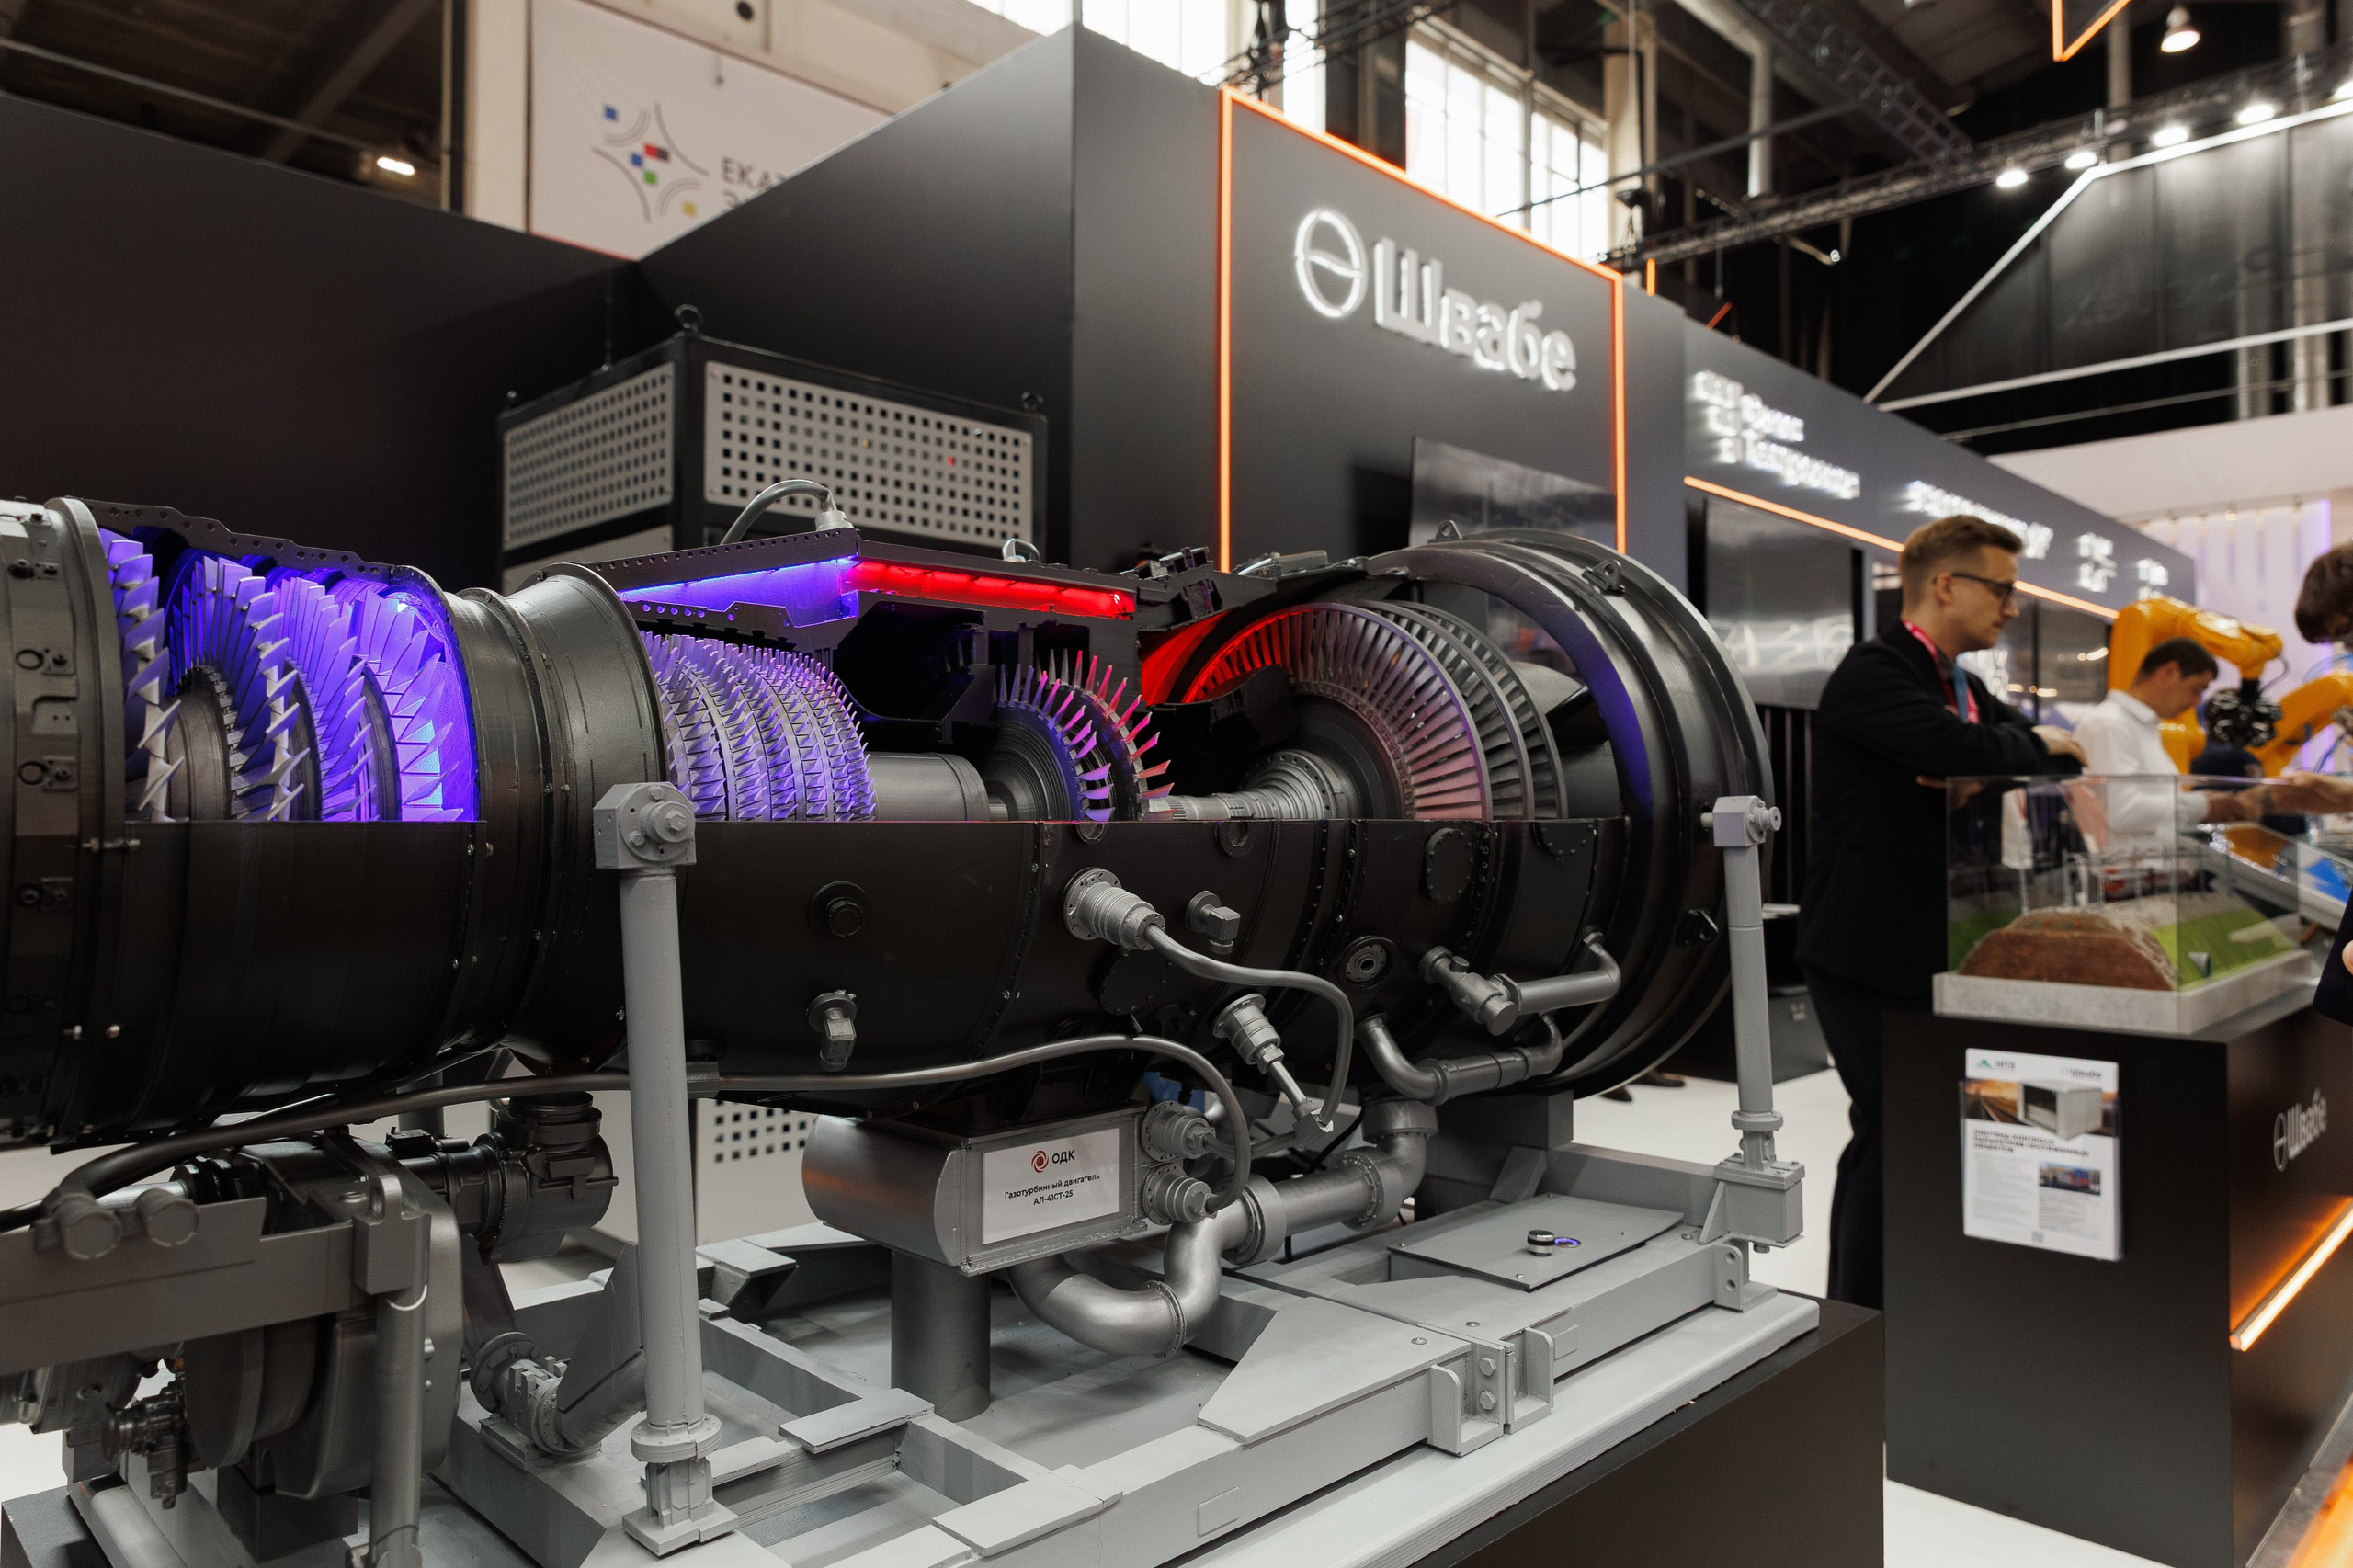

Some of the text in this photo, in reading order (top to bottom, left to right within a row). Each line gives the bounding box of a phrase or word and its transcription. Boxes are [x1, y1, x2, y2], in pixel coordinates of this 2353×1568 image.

[722, 156, 784, 190] ЕКА
[1375, 235, 1577, 392] Швабе
[2287, 1088, 2327, 1160] Швабе
[1051, 1150, 1075, 1164] ОДК
[1005, 1173, 1100, 1199] Газотурбинный двигатель
[1033, 1189, 1074, 1205] АЛ-41СТ-25
